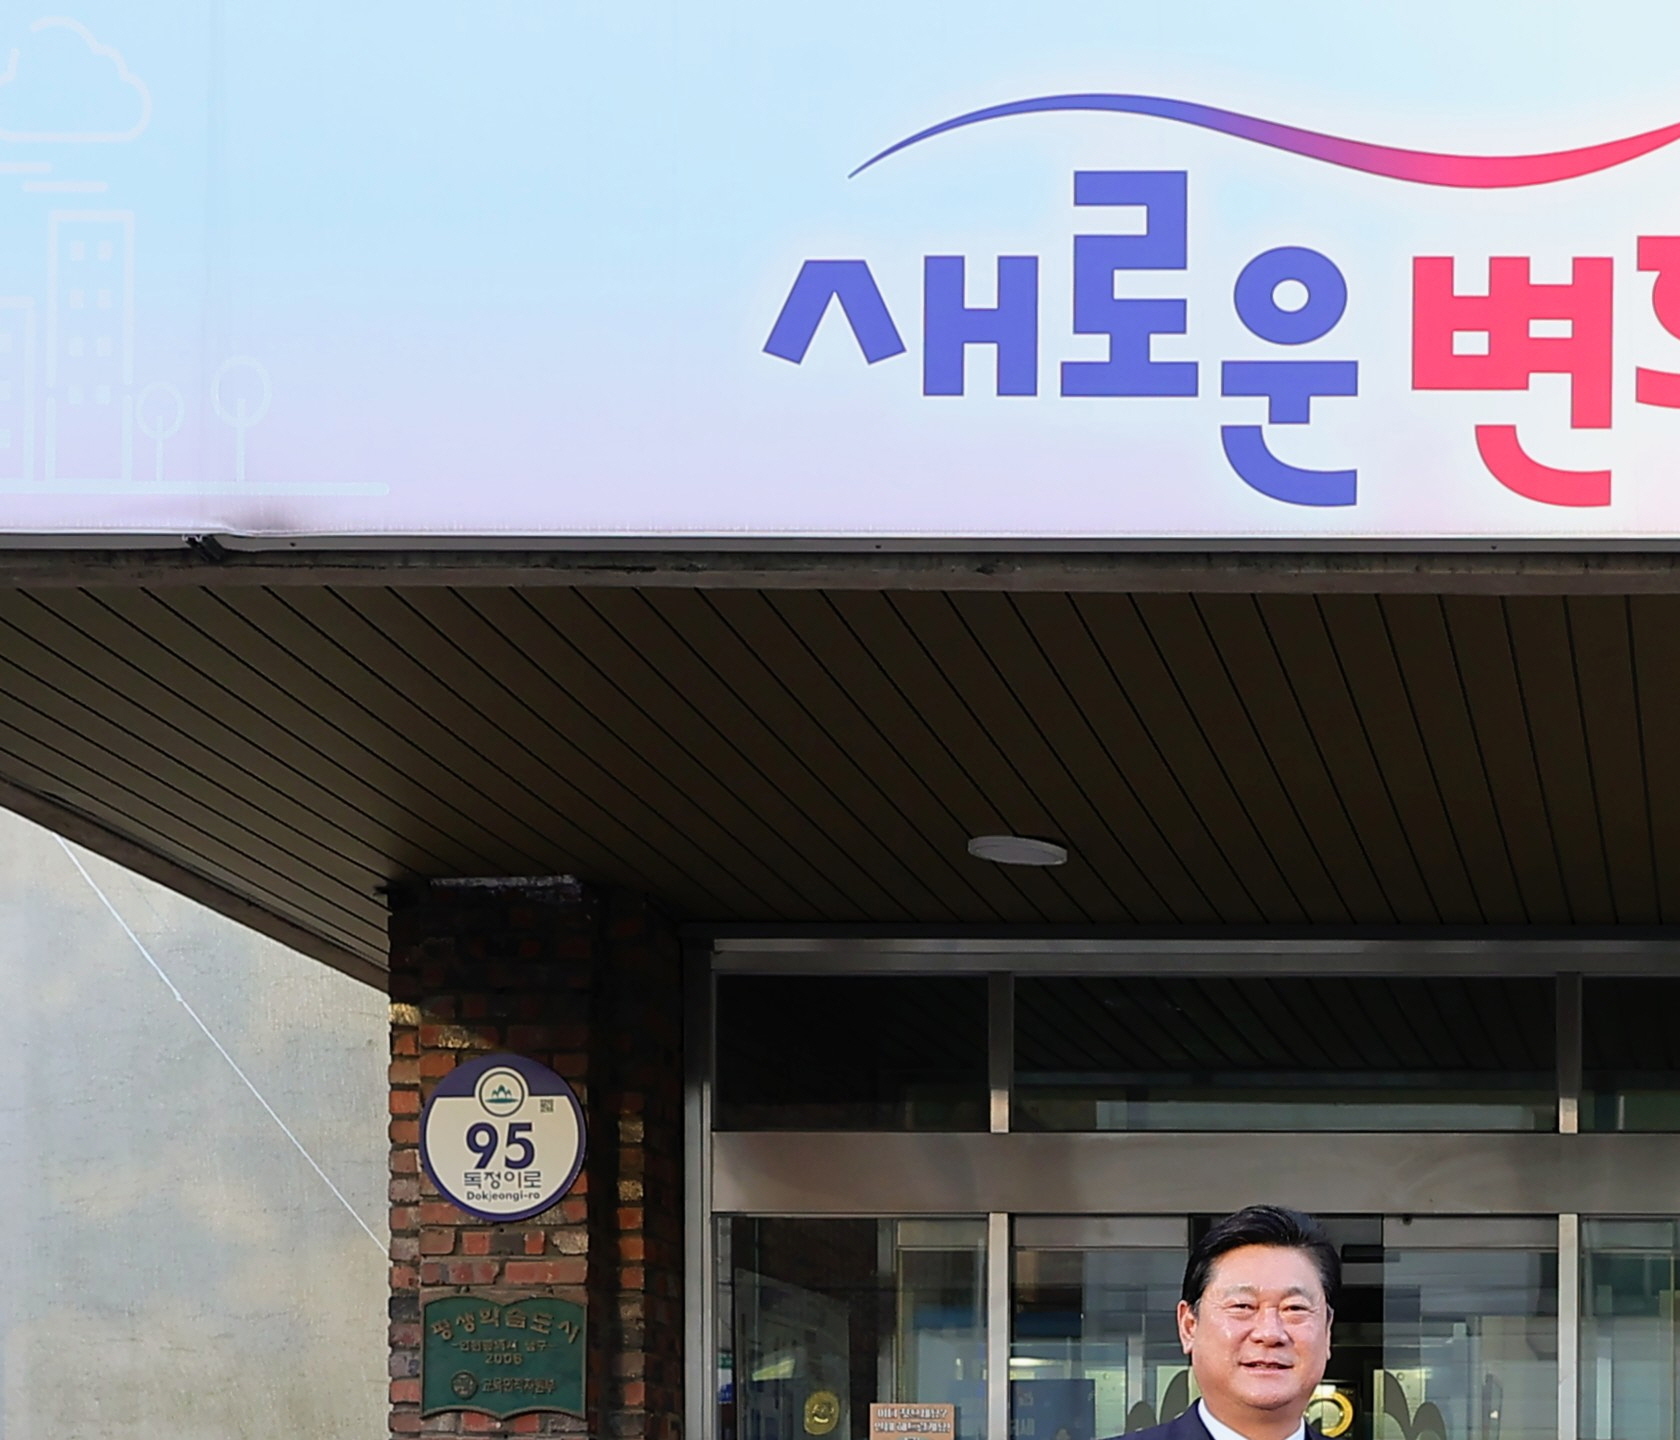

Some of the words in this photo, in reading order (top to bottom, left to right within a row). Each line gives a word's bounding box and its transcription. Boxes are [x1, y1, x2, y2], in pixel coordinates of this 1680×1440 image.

[763, 170, 1358, 505] 새로운
[466, 1122, 535, 1169] 95
[464, 1171, 541, 1190] 독정이로
[467, 1190, 540, 1202] Dokjeongi-ro
[485, 1353, 523, 1365] 2006
